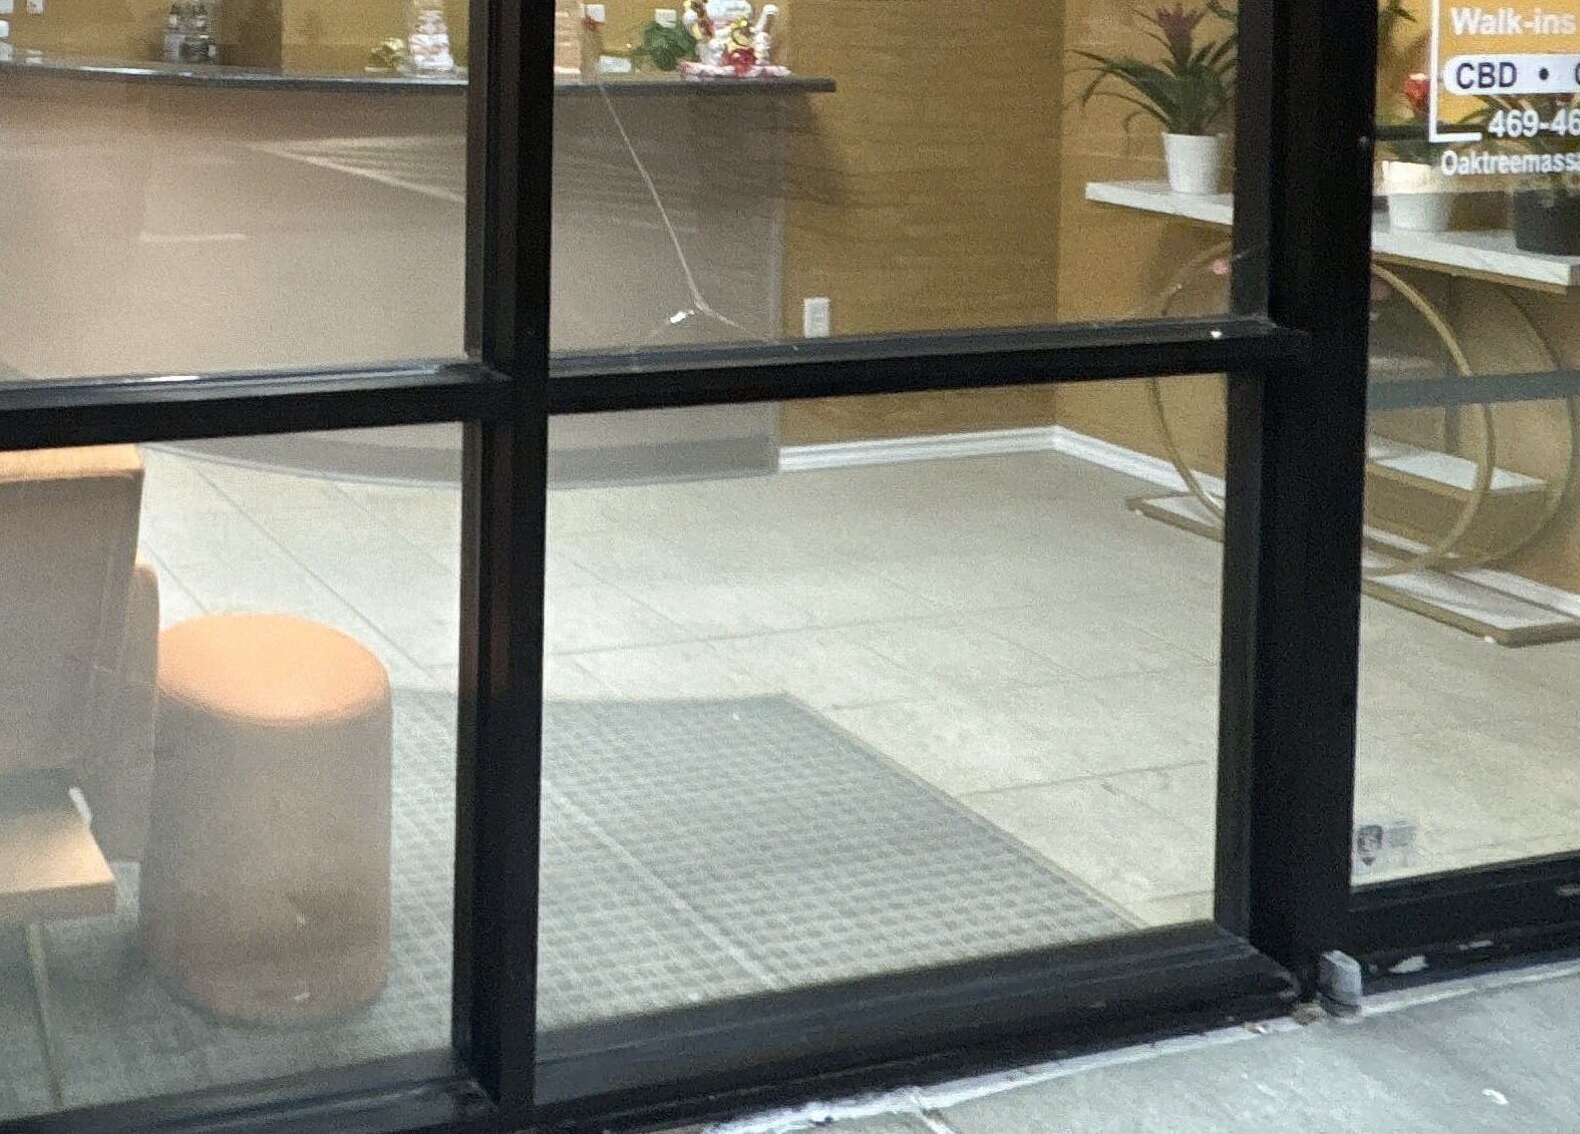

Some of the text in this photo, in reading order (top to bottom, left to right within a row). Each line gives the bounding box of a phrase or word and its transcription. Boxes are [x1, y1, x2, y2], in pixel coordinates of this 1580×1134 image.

[1450, 7, 1577, 35] Walk-ins
[1456, 62, 1518, 89] CBD
[1441, 150, 1580, 176] Oaktreemass
